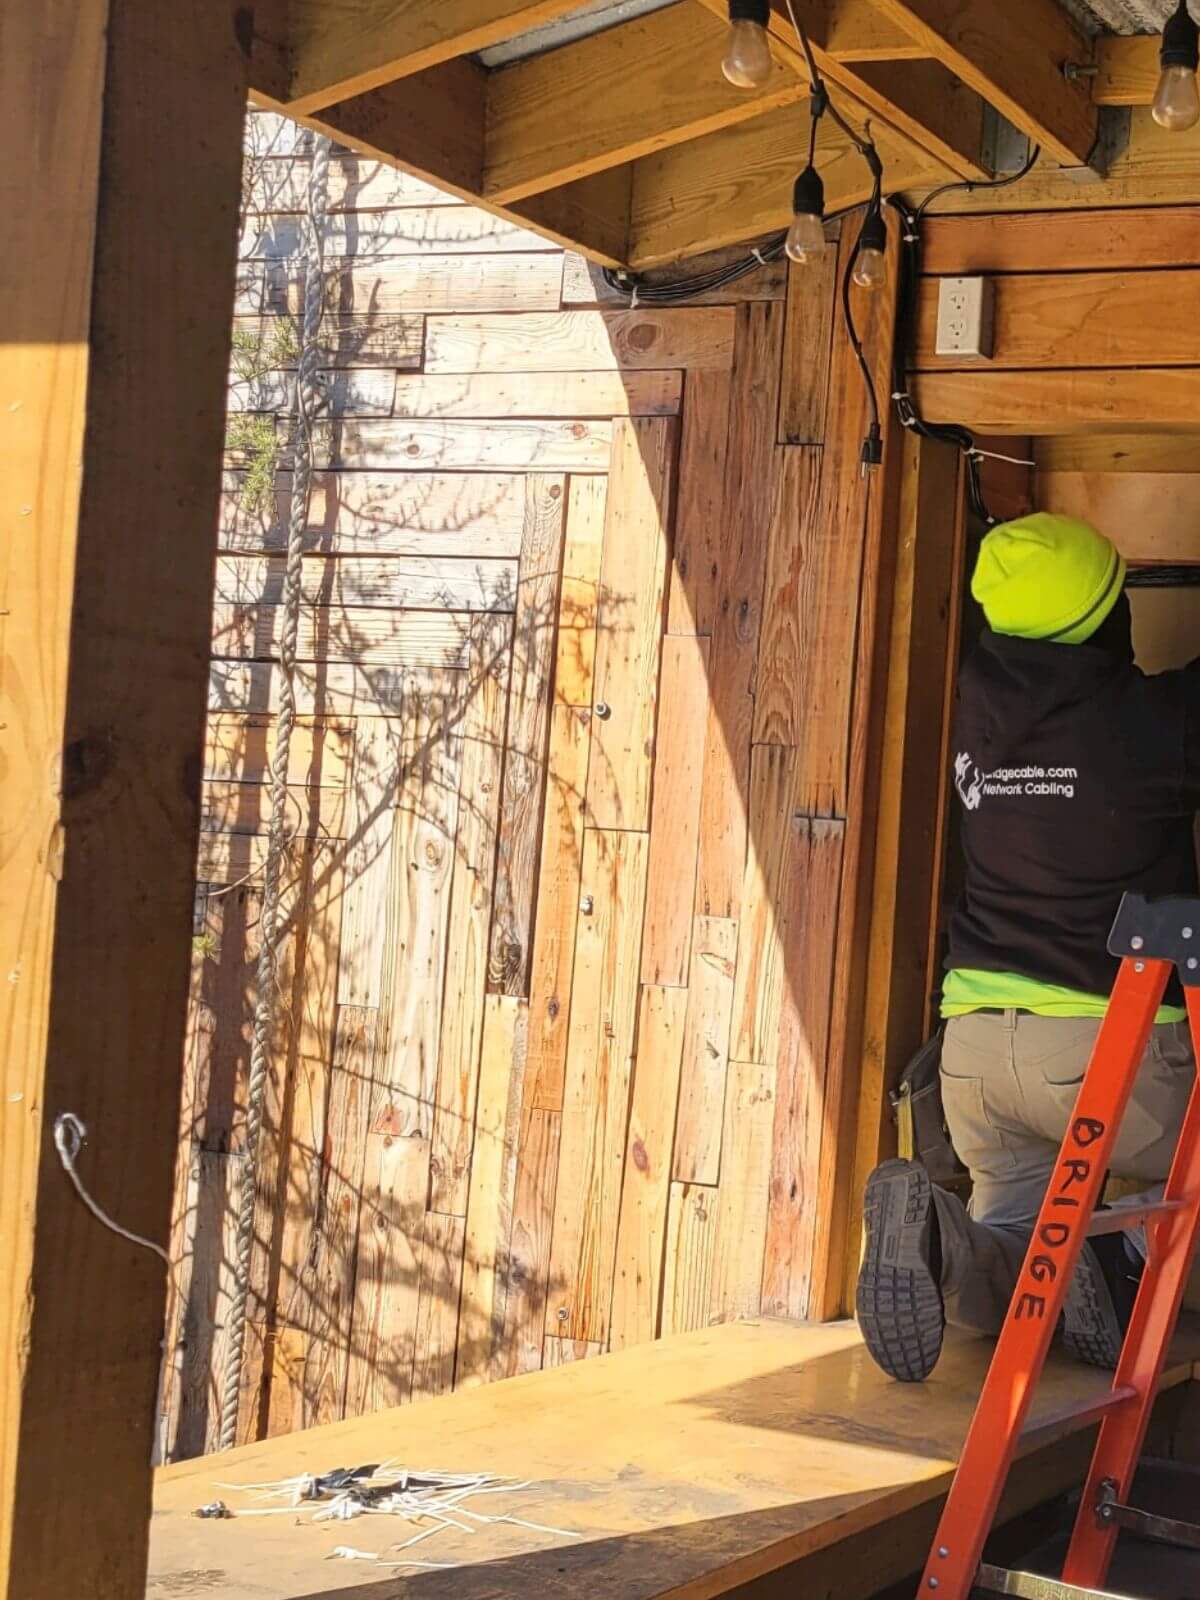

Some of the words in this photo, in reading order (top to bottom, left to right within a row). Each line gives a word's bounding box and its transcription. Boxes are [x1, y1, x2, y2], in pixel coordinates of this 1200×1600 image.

[983, 766, 1079, 783] idgecable.com
[982, 783, 1023, 796] Network
[1024, 782, 1075, 799] Cabling
[1014, 1117, 1106, 1321] BRIDGE
